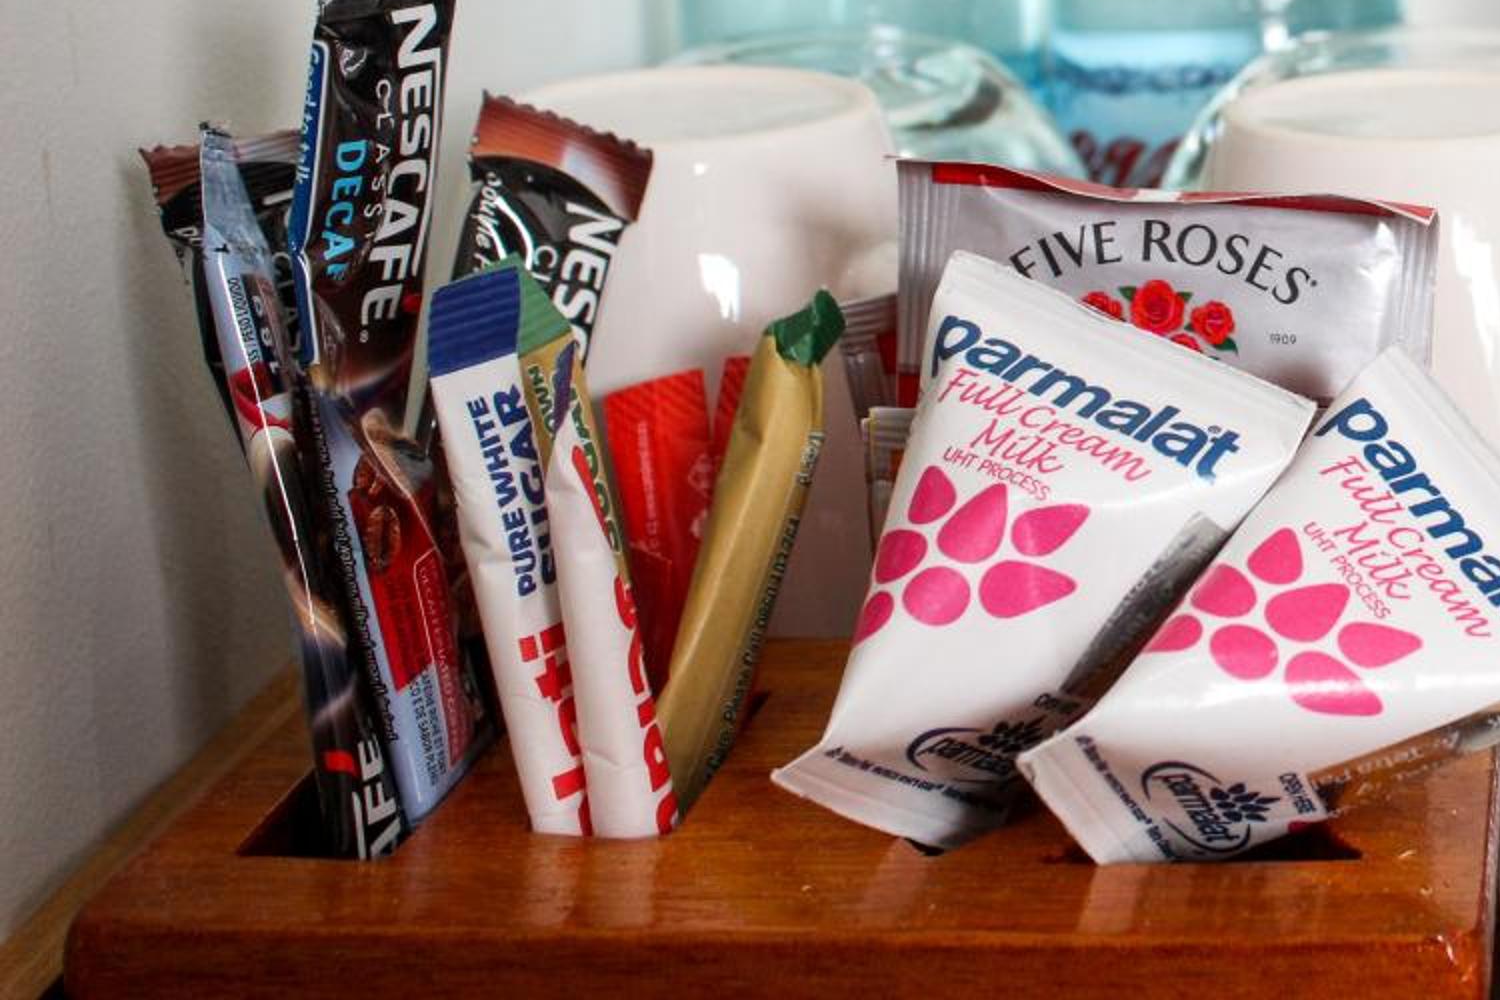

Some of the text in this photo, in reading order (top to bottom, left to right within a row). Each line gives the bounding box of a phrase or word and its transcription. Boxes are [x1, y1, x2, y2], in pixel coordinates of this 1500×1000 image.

[1008, 219, 1312, 305] FIVE ROSES
[932, 315, 1241, 485] parmalat
[938, 367, 1152, 482] Full Cream
[970, 418, 1063, 474] Milk
[467, 396, 537, 597] PURE WHITE
[943, 446, 1051, 501] UHT PROCESS
[1303, 520, 1391, 619] UHT PROCESS
[1319, 455, 1404, 524] Full
[1387, 526, 1491, 638] Cream
[1334, 521, 1413, 600] Milk
[1152, 772, 1241, 843] parmalat
